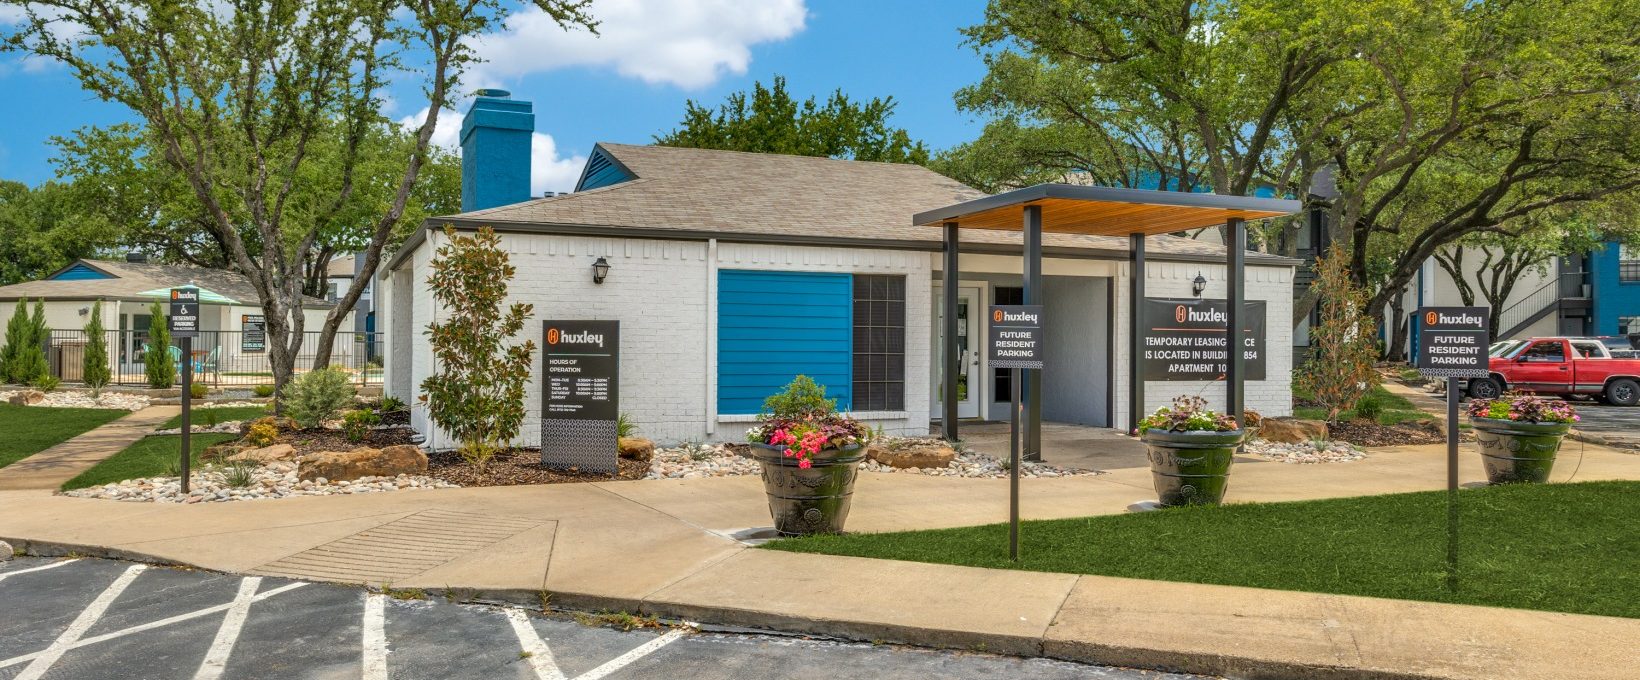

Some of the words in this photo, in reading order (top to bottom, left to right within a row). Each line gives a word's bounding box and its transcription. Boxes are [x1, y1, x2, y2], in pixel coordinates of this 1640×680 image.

[1004, 312, 1037, 324] huxley
[1440, 313, 1482, 327] huxley
[561, 330, 603, 347] huxley
[1145, 336, 1193, 346] TEMPORARY
[1194, 337, 1227, 346] LEASING
[1145, 350, 1153, 359] IS
[1154, 350, 1191, 360] LOCATED
[1192, 350, 1201, 359] IN
[1168, 364, 1214, 372] APARTMENT
